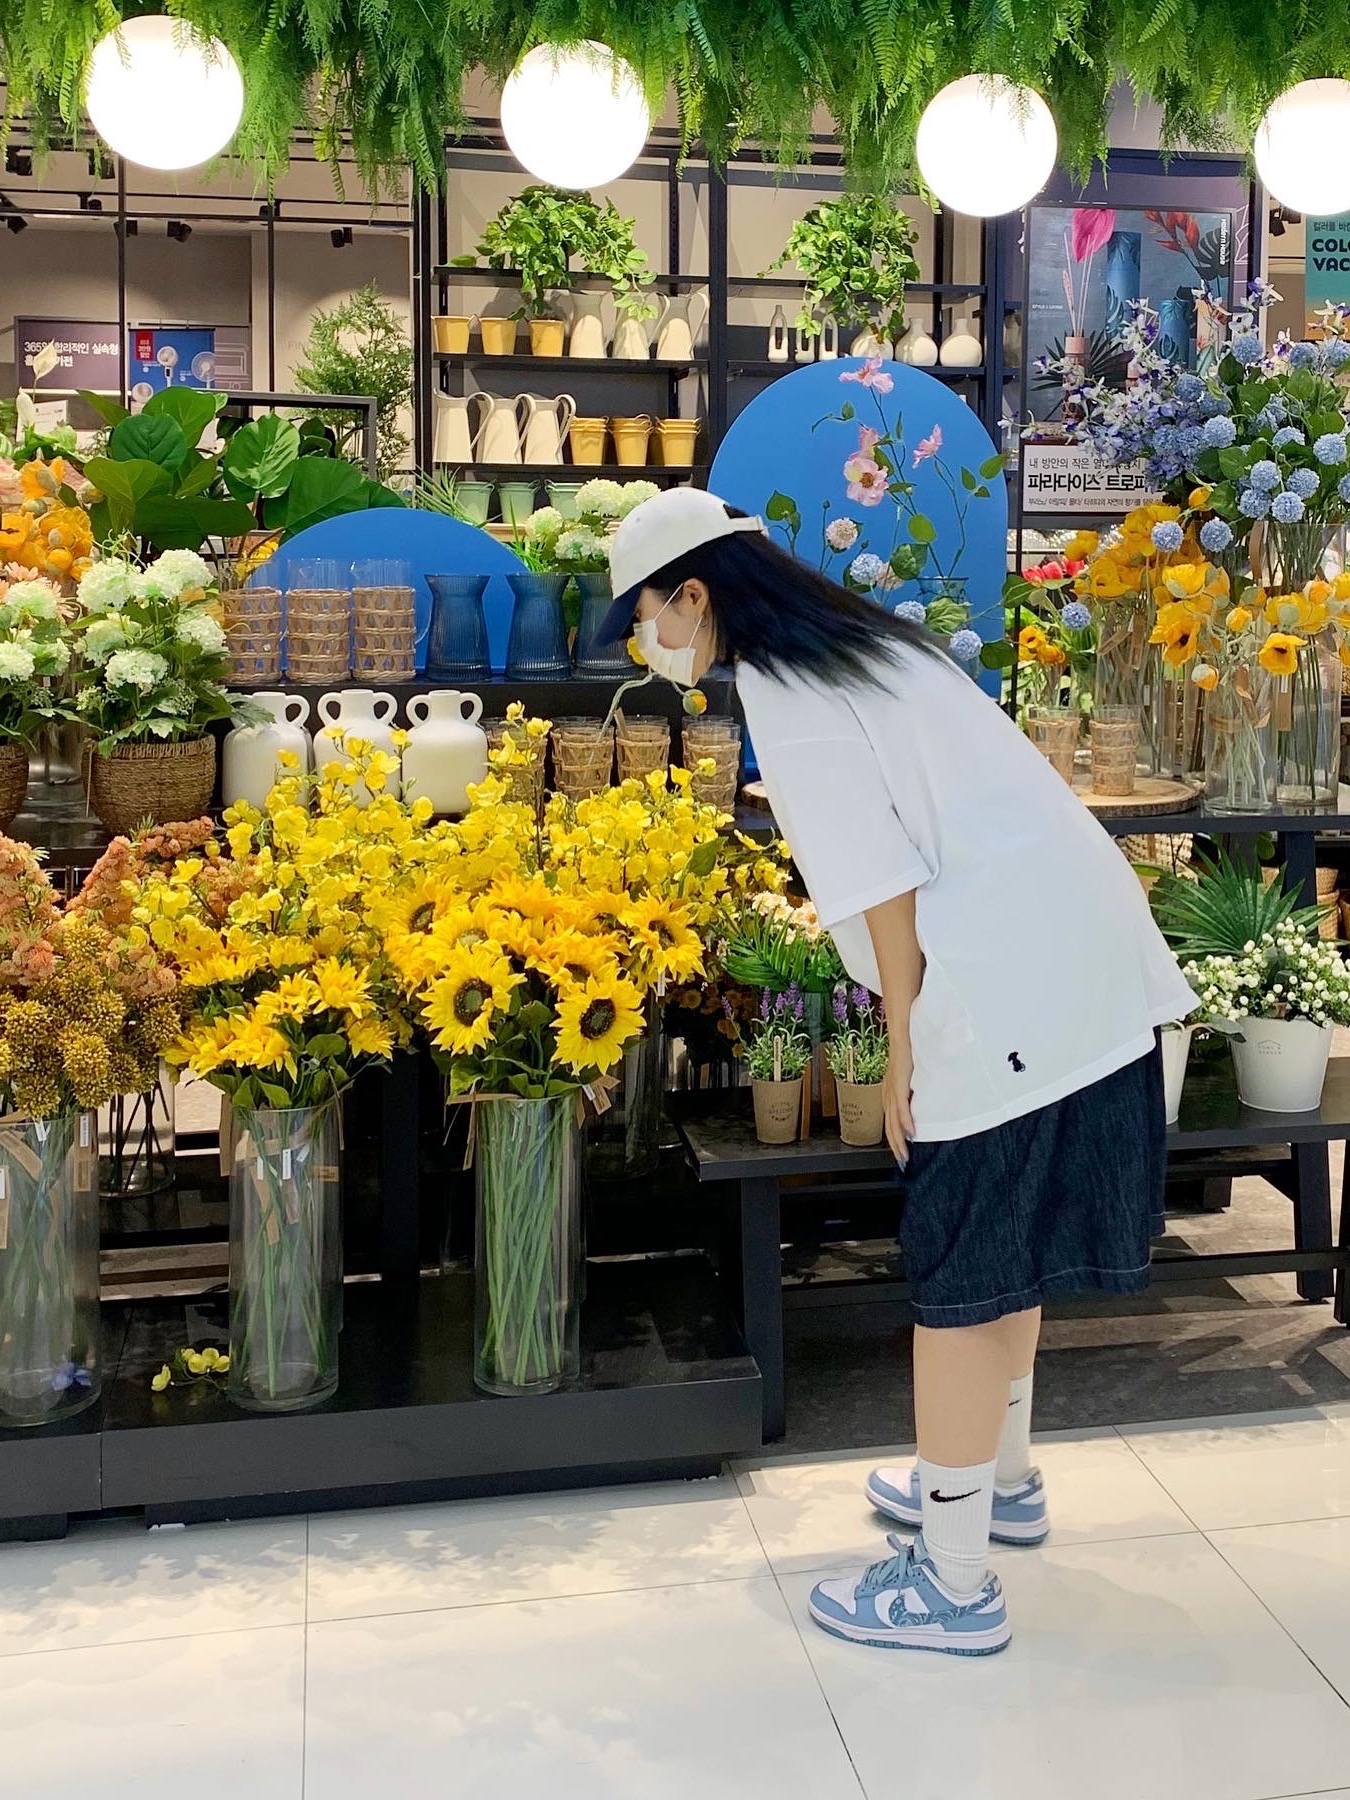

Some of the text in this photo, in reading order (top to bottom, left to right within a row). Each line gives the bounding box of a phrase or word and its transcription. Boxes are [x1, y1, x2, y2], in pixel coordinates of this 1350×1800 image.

[1312, 238, 1350, 252] COL
[1029, 457, 1038, 469] 내
[1041, 457, 1069, 469] 방안의
[1071, 457, 1090, 469] 작은
[1028, 473, 1163, 492] 파라다이스 트로피
